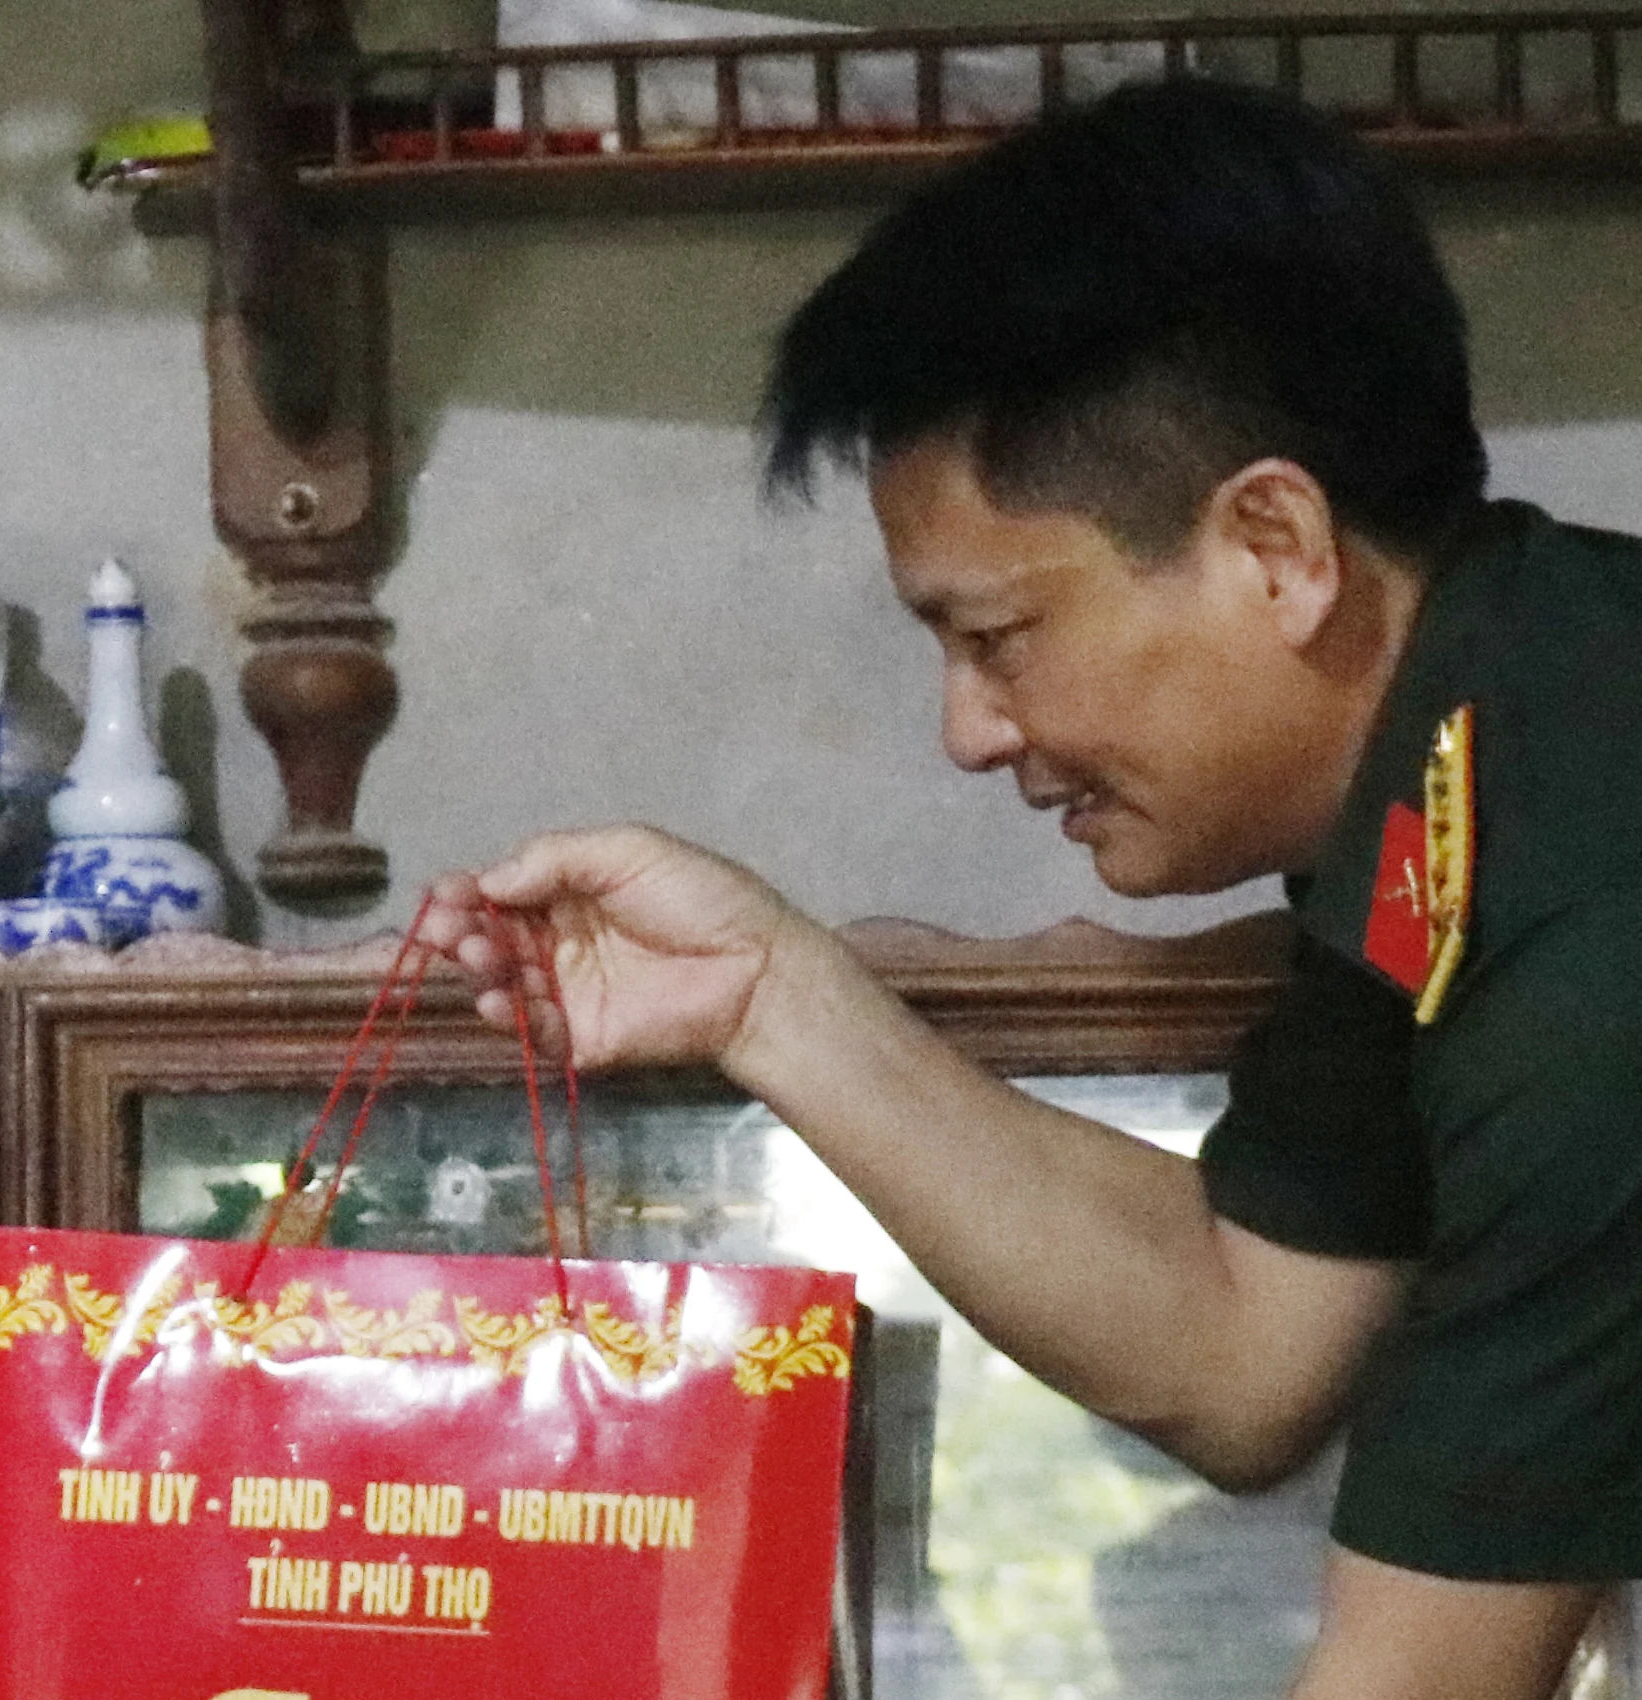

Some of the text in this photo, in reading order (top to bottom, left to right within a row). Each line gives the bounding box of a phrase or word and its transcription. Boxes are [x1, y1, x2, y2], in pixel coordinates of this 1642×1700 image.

[149, 1450, 199, 1526] ỦY
[229, 1476, 332, 1531] HĐND
[364, 1482, 465, 1537] UBND
[498, 1487, 695, 1552] UBMTTQVN
[247, 1538, 491, 1633] TỈNH PHÚ THỌ
